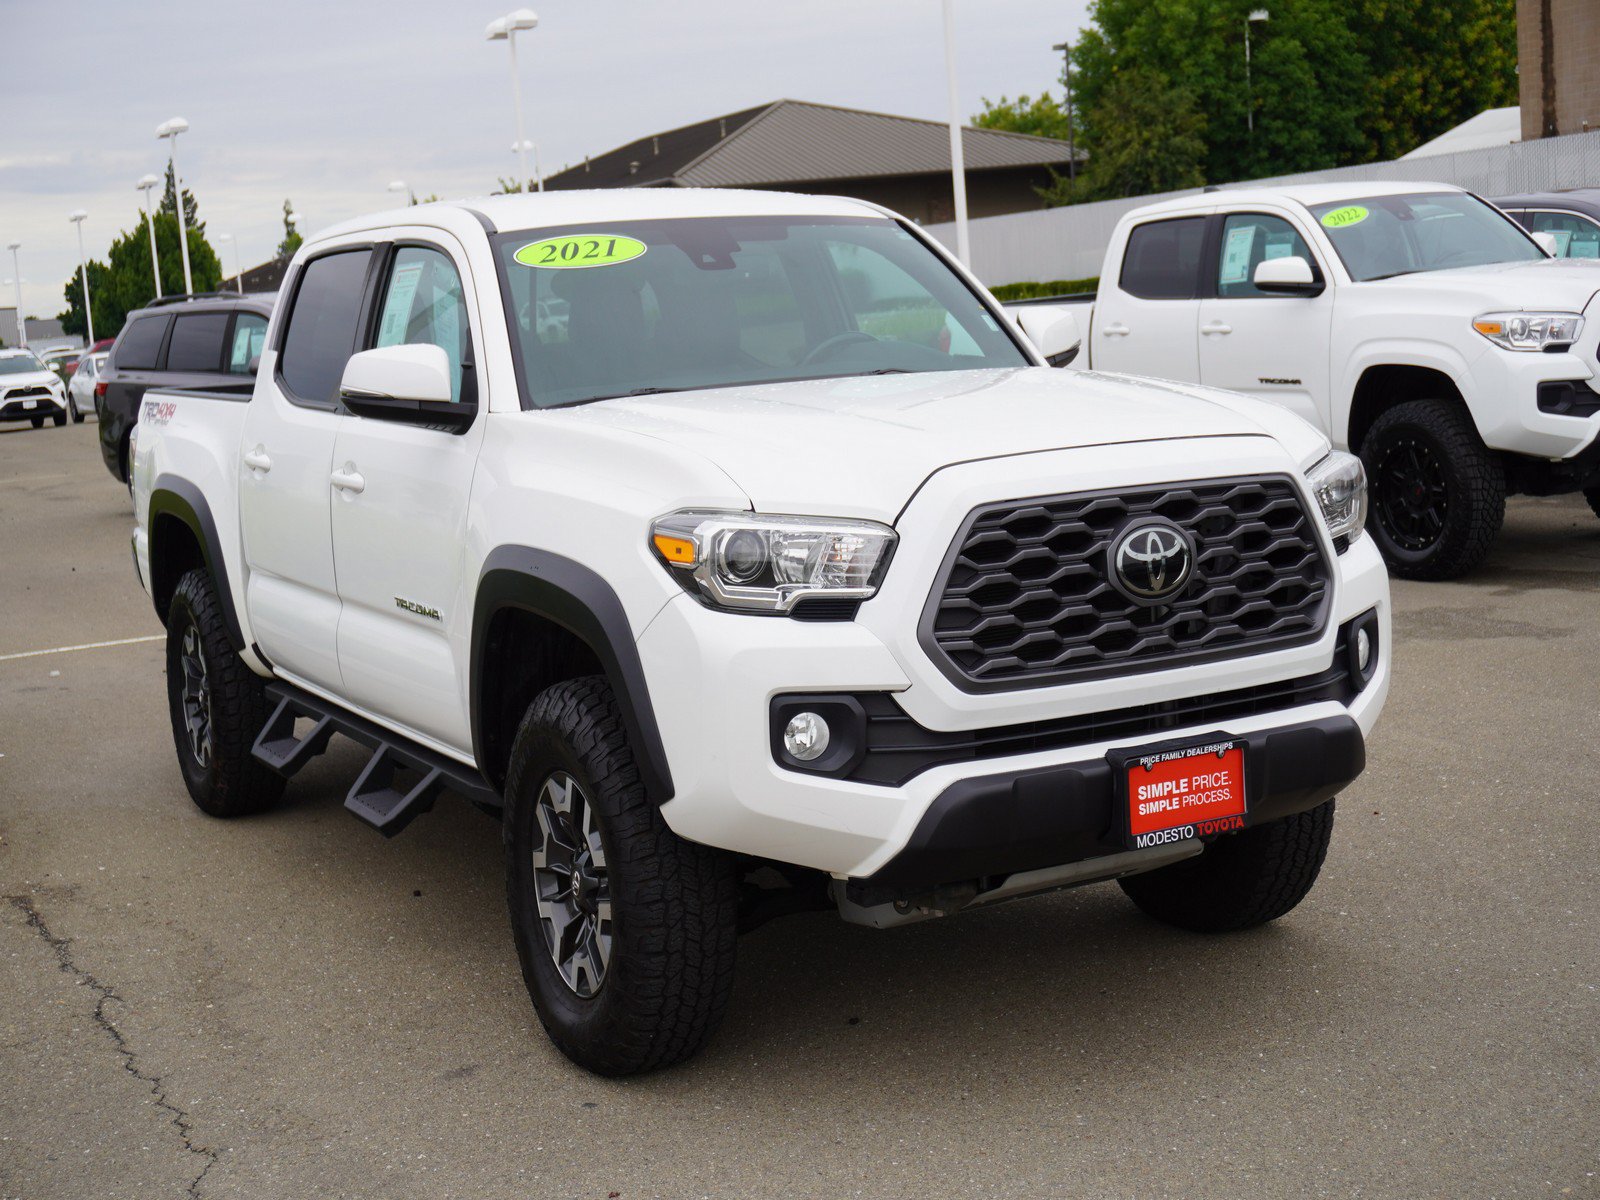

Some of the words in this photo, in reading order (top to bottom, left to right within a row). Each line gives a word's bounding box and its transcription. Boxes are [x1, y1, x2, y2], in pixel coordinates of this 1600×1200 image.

[1330, 208, 1360, 226] 2022
[538, 238, 617, 264] 2021
[394, 596, 441, 621] TACOMA
[1140, 754, 1160, 766] PRICE
[1161, 750, 1186, 762] FAMILY
[1186, 741, 1234, 757] DEALERSHIPS
[1138, 778, 1189, 800] SIMPLE
[1192, 770, 1232, 791] PRICE.
[1138, 797, 1180, 816] SIMPLE
[1182, 788, 1233, 808] PROCESS.
[1136, 825, 1194, 849] MODESTO
[1196, 815, 1245, 837] TOYOTA
